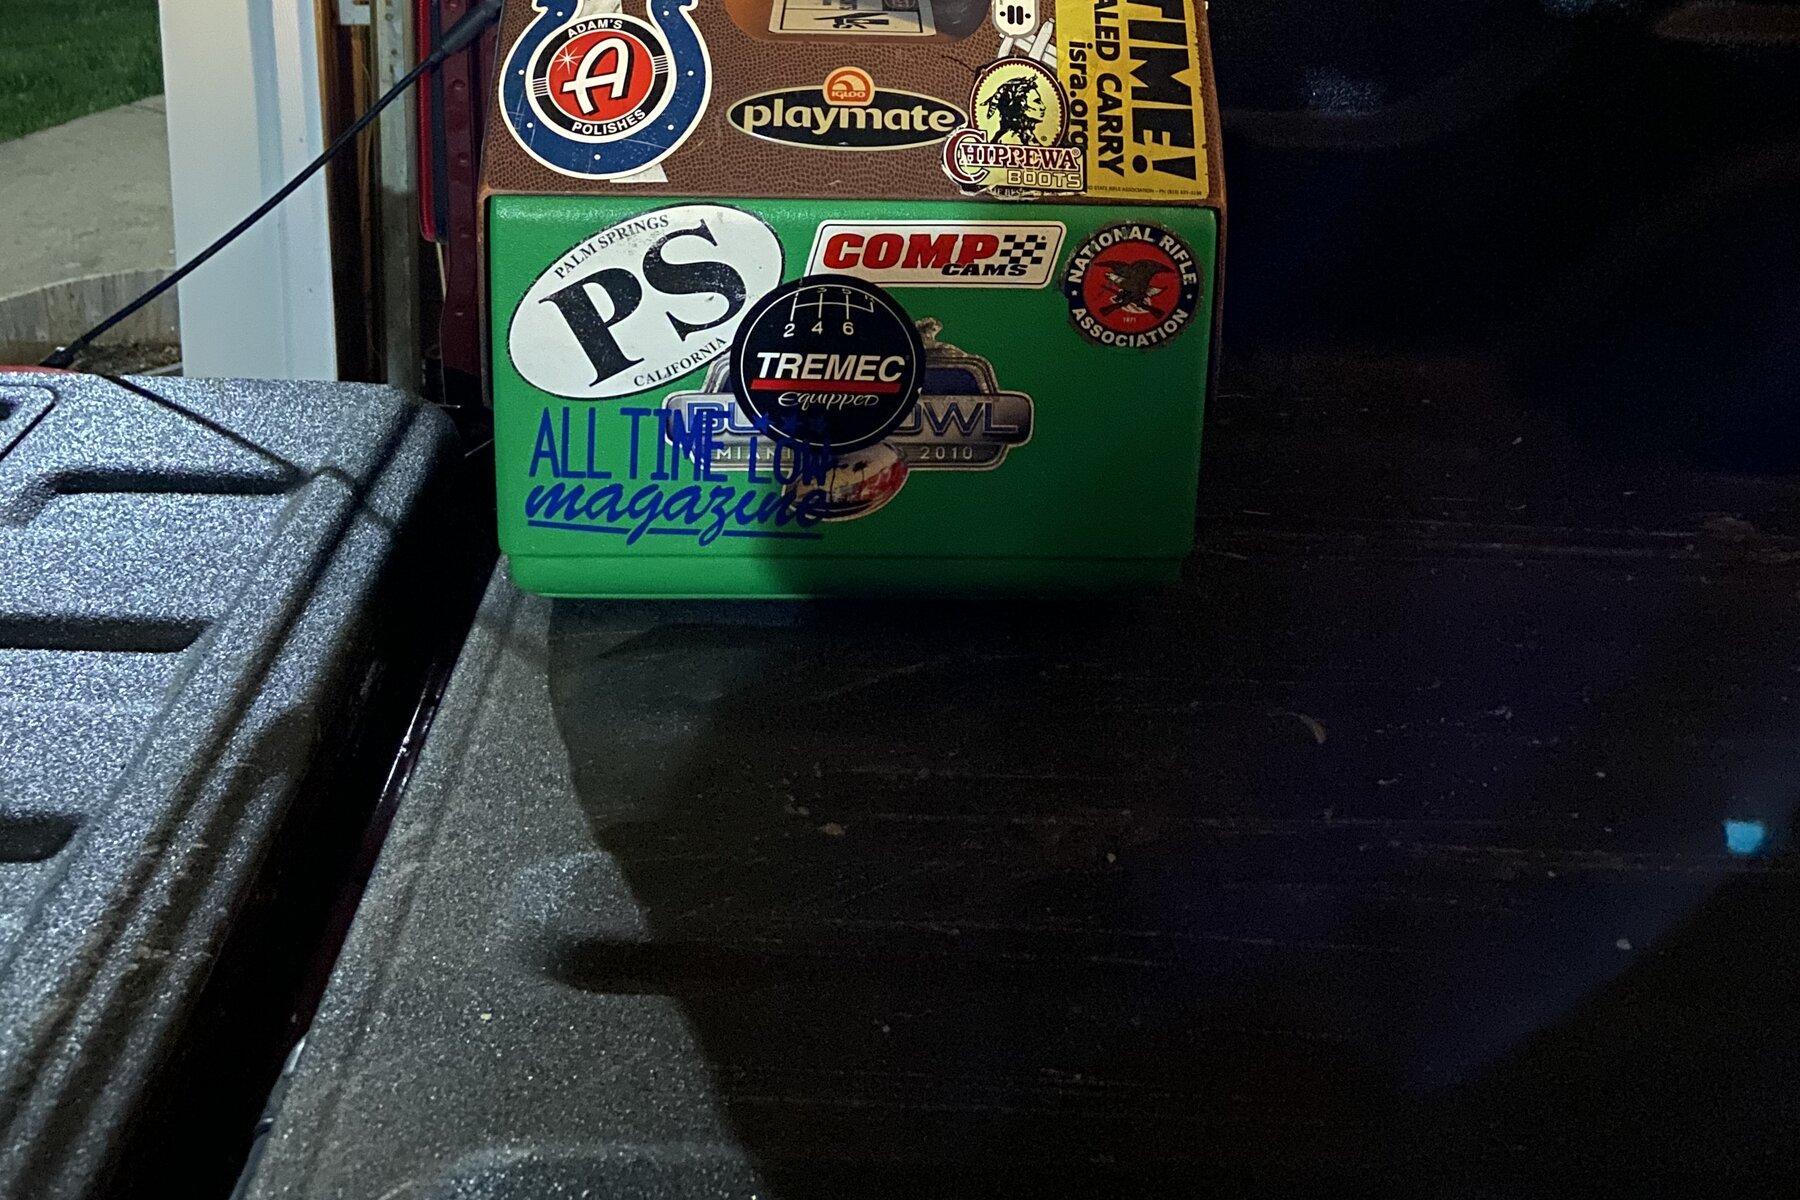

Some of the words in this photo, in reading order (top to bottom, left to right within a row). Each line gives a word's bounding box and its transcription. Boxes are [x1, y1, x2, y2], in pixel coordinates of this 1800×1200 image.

[567, 19, 623, 39] ADAM'S
[561, 37, 632, 115] A
[831, 89, 867, 99] IGLOO
[571, 109, 646, 135] POLISHES
[743, 98, 956, 136] playmate
[1096, 72, 1125, 178] CARRY
[1007, 170, 1081, 189] BOOTS
[554, 245, 597, 280] PALM
[598, 214, 670, 249] SPRINGS
[823, 232, 1000, 270] COMP
[1068, 225, 1155, 284] NATIONAL
[1159, 234, 1197, 286] RIFLE
[941, 263, 1029, 277] CAMS
[538, 218, 747, 388] PS
[783, 323, 796, 338] 2
[811, 321, 824, 335] 4
[842, 321, 855, 336] 6
[1072, 307, 1189, 348] ASSOCIATION
[633, 337, 728, 387] CALIFORNIA
[756, 351, 906, 383] TREMEC
[528, 406, 612, 479] ALL
[620, 407, 729, 483] TIME
[748, 435, 828, 487] LOW
[920, 446, 974, 460] 2010
[524, 481, 825, 547] magazine
